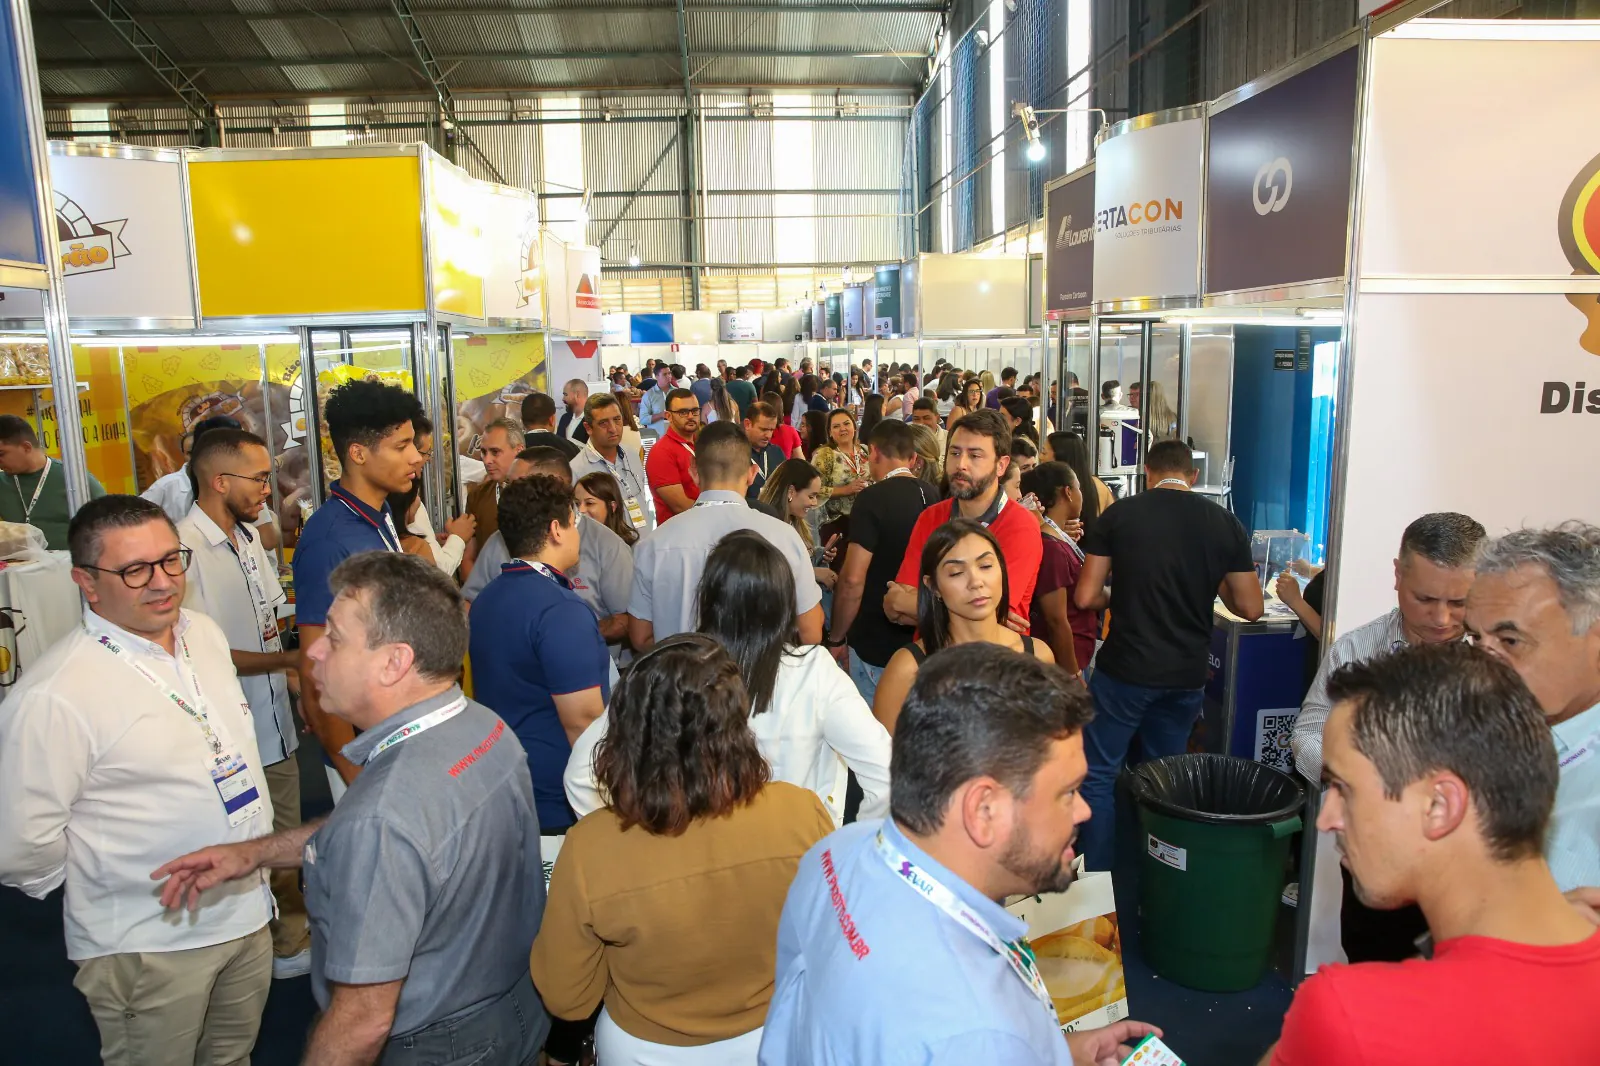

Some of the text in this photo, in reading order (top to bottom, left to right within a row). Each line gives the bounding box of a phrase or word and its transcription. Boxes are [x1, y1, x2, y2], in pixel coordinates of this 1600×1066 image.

[1097, 198, 1183, 233] ERTACON
[1141, 225, 1182, 235] TRIBUTÁRIAS
[283, 359, 301, 382] Bisc
[1208, 653, 1221, 669] ELO
